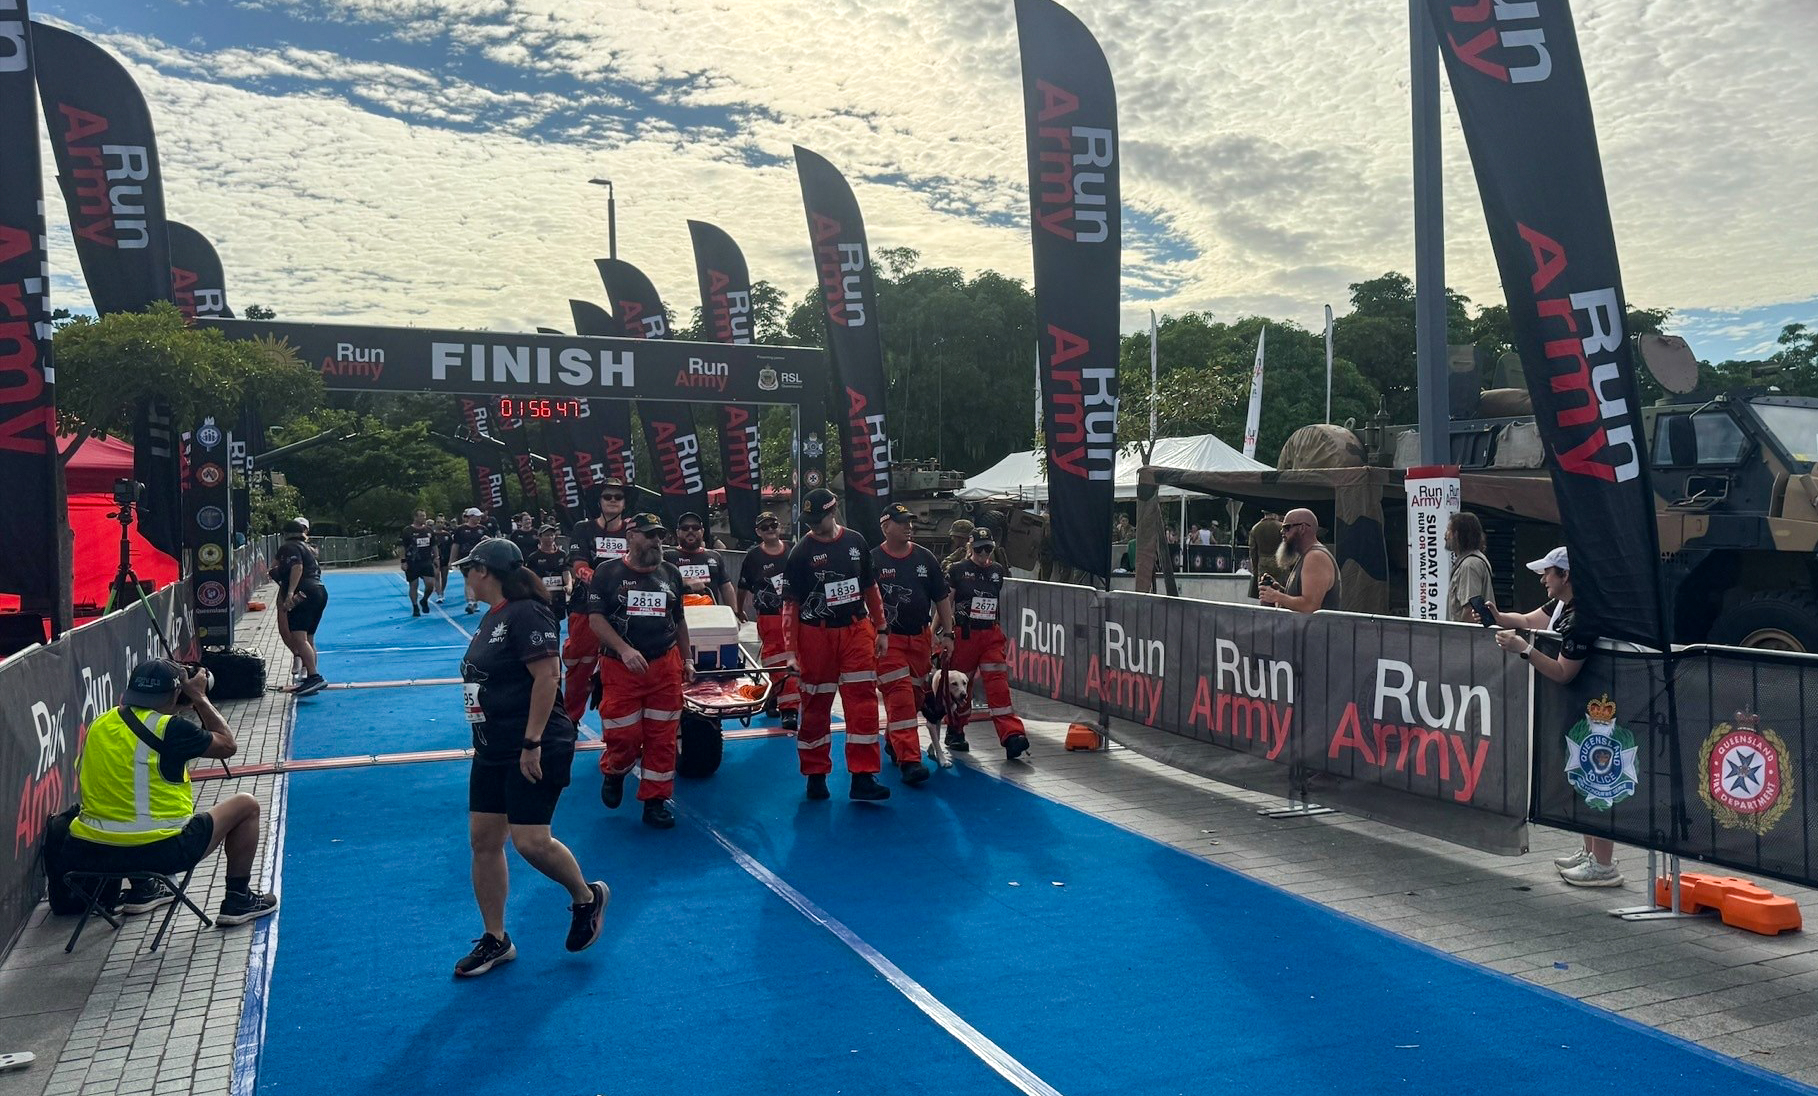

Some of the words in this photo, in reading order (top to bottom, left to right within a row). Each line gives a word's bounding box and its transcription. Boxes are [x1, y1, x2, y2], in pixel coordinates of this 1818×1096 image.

[58, 102, 116, 248] Army
[1035, 78, 1079, 241] Army
[102, 144, 149, 249] Run
[1072, 126, 1113, 243] Run
[812, 211, 849, 326] Army
[838, 243, 866, 327] Run
[321, 357, 384, 381] Army
[337, 343, 384, 363] Run
[432, 342, 635, 387] FINISH
[689, 358, 729, 376] Run
[1517, 221, 1616, 483] Army
[675, 370, 728, 391] Army
[781, 372, 803, 383] RSL
[1571, 287, 1639, 483] Run
[1047, 323, 1090, 480] Army
[651, 421, 687, 495] Army
[725, 405, 753, 490] Army
[846, 386, 877, 496] Army
[674, 433, 703, 495] Run
[489, 473, 503, 508] Run
[1411, 495, 1442, 509] Army
[1419, 485, 1442, 497] Run
[1417, 512, 1425, 533] RUN
[1418, 535, 1426, 550] OR
[600, 541, 623, 550] 2830
[813, 553, 828, 562] Run
[1419, 552, 1427, 580] WALK
[1426, 514, 1438, 579] SUNDAY
[633, 597, 661, 607] 2818
[831, 585, 855, 597] 1839
[975, 602, 995, 610] 2672
[1419, 582, 1427, 605] 5KM
[1428, 581, 1438, 598] 19
[1020, 608, 1065, 656] Run
[1105, 621, 1165, 677] Run
[1006, 637, 1064, 699] Army
[1085, 653, 1163, 726] Army
[1216, 638, 1293, 704] Run
[1188, 676, 1292, 760] Army
[1374, 659, 1492, 737] Run
[1328, 702, 1490, 801] Army
[1581, 736, 1621, 766] QUEENSLAND
[1718, 735, 1774, 762] QUEENSLAND
[1588, 769, 1616, 784] POLICE
[1713, 773, 1721, 794] FIRE
[1720, 782, 1775, 809] DEPARTMENT
